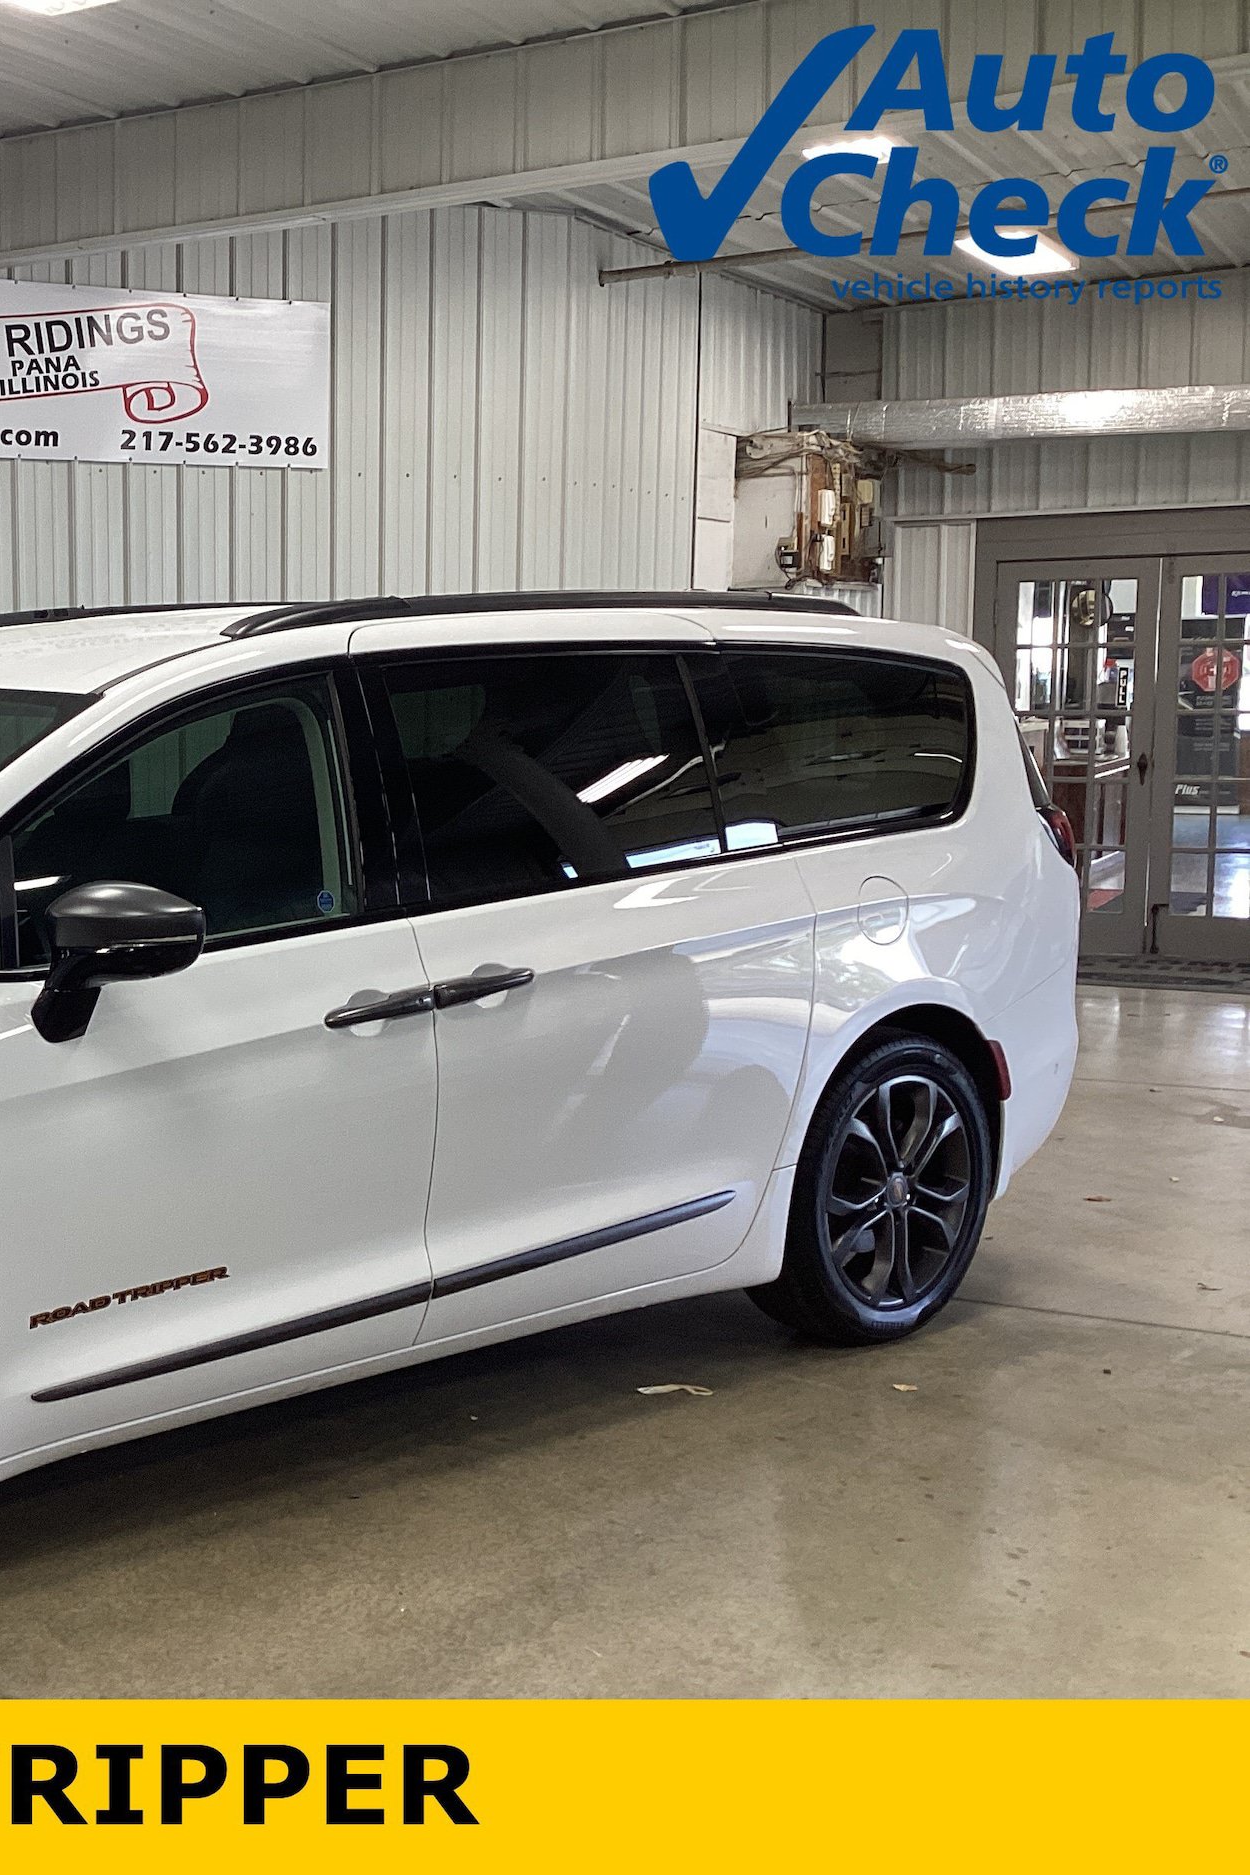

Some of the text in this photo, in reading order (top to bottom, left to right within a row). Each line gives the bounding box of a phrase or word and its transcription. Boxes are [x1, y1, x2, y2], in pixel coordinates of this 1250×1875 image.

[4, 308, 171, 358] RIDINGS
[11, 354, 82, 377] PANA
[0, 370, 101, 397] ILLINOIS
[120, 428, 319, 458] 217-562-3986
[1118, 669, 1128, 704] PULL
[1174, 783, 1201, 797] Plus
[29, 1266, 231, 1330] ROAD TRIPPER
